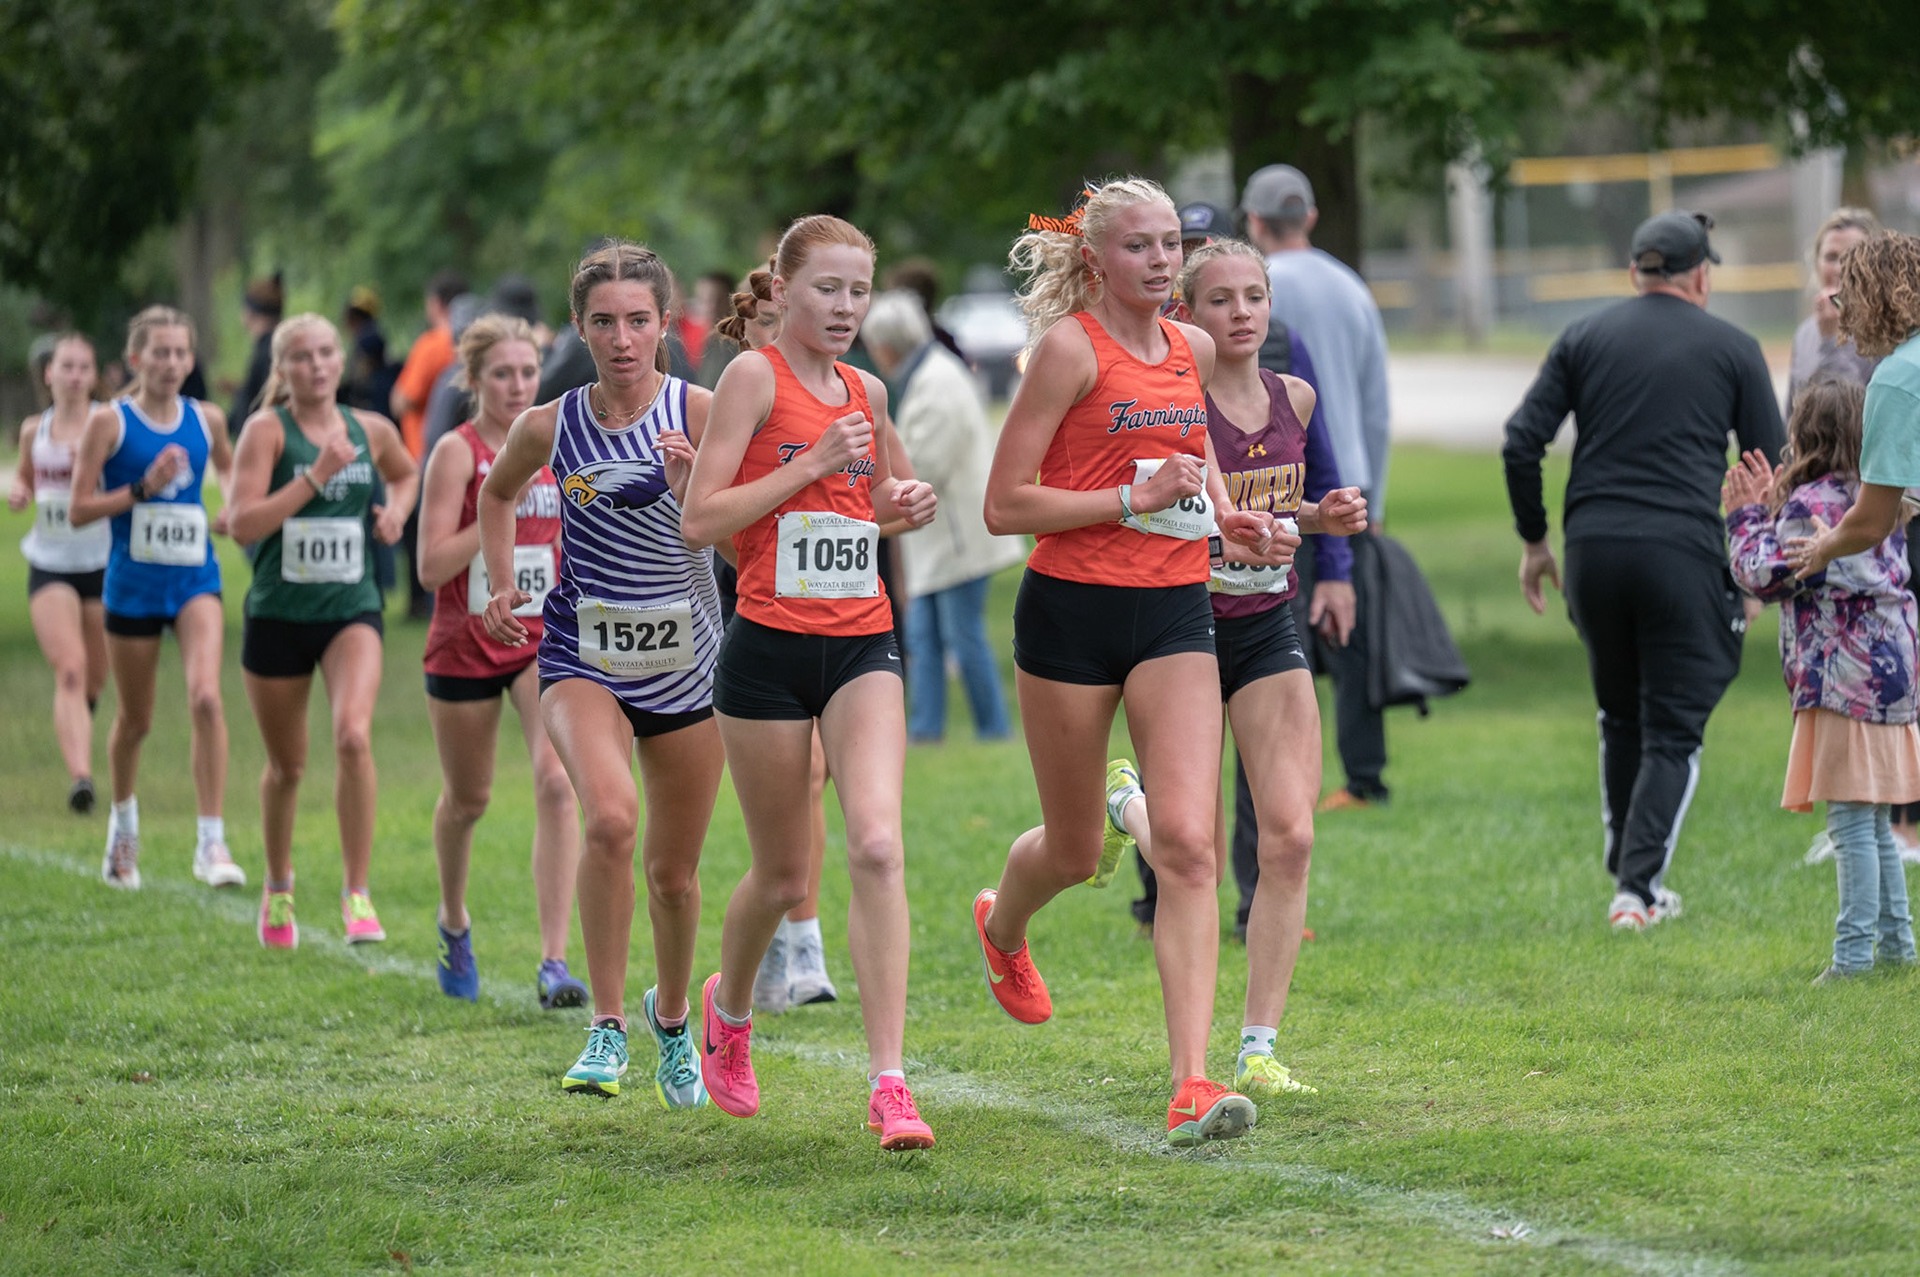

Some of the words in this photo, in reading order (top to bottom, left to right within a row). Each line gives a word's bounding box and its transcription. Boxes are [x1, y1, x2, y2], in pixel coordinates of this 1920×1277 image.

[1149, 516, 1177, 527] WAYZATA
[297, 539, 351, 562] 1011
[793, 537, 869, 571] 1058
[593, 620, 680, 652] 1522
[645, 658, 676, 667] RESULTS
